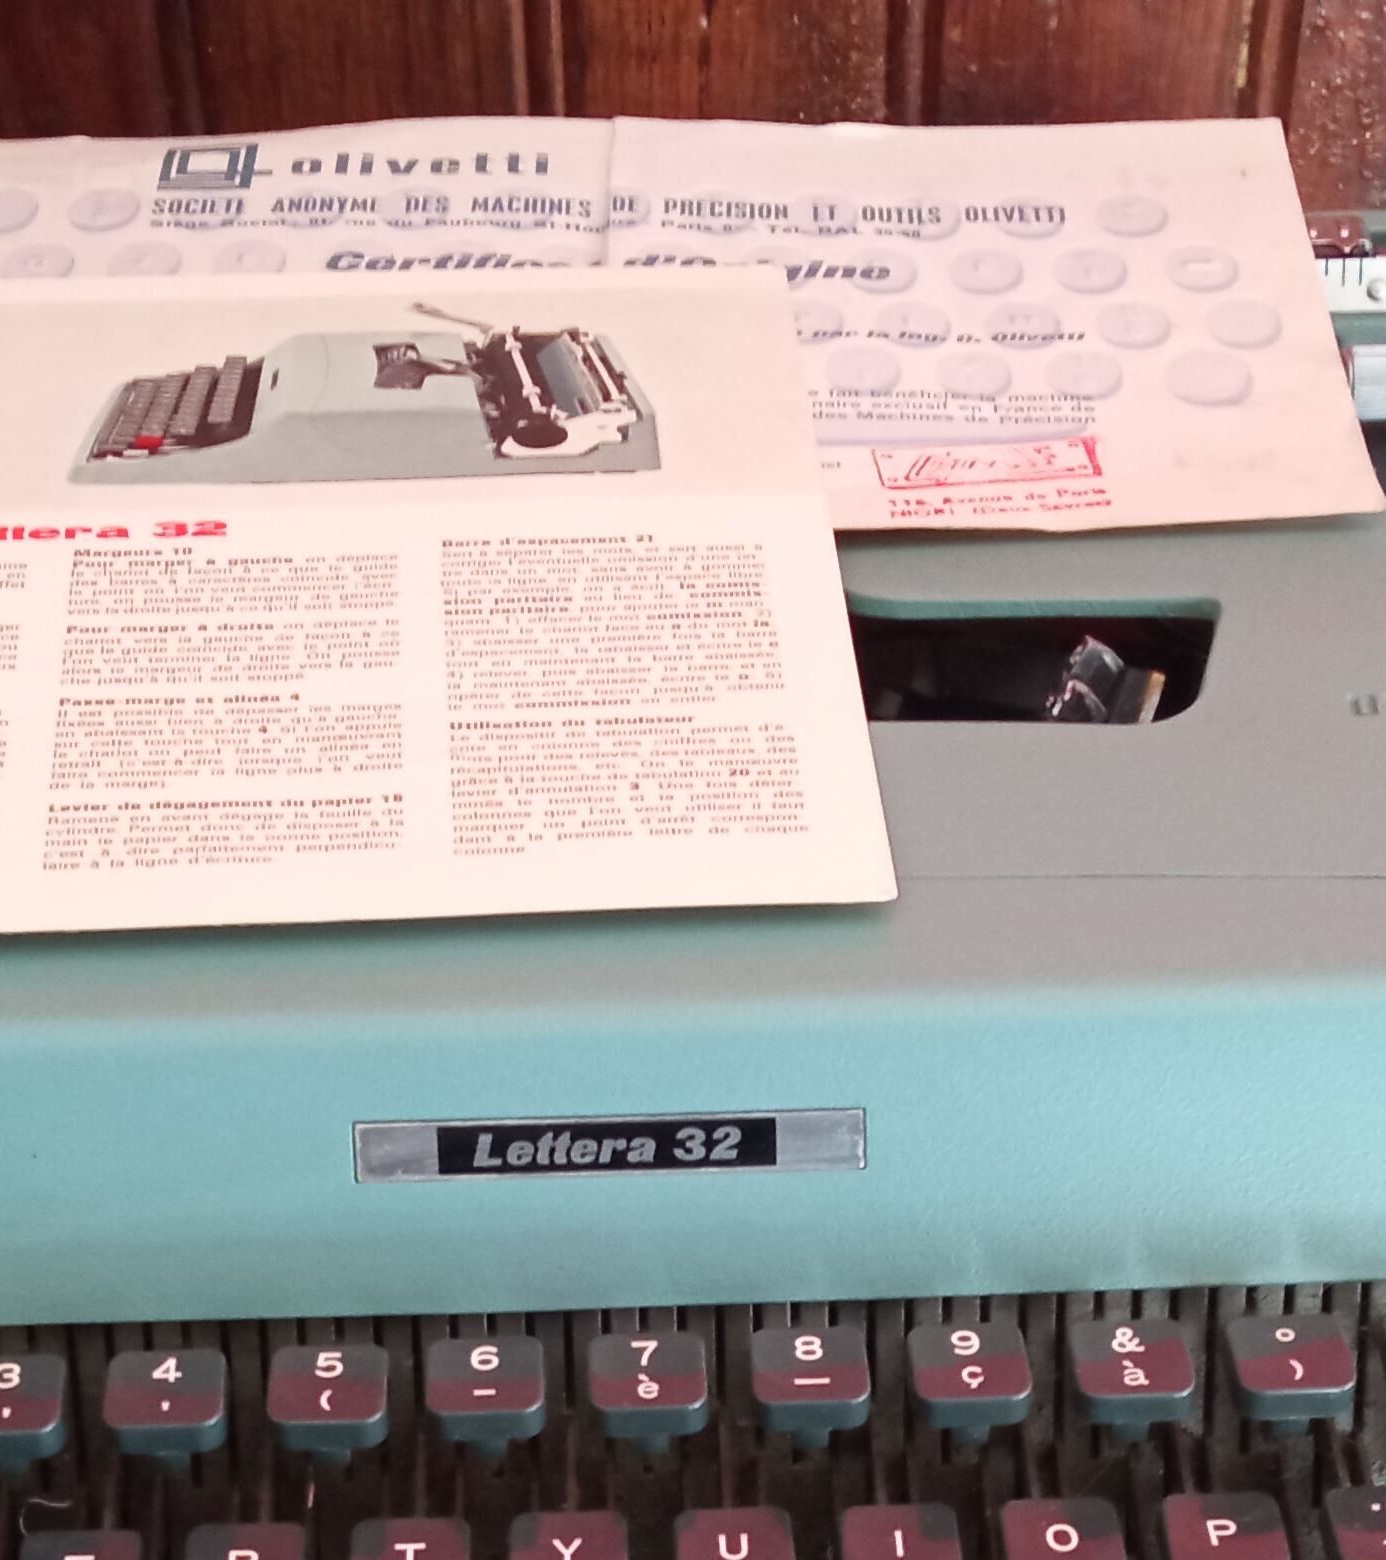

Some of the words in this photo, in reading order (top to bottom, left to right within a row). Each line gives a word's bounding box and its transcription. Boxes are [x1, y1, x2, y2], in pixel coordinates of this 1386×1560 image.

[290, 152, 549, 175] olivetti
[271, 196, 376, 214] ANONYME
[405, 196, 448, 212] DES
[471, 197, 591, 218] MACHINES
[610, 196, 637, 212] DE
[811, 204, 837, 221] ET
[860, 205, 940, 224] OUTILS
[964, 205, 1065, 224] OLIVETTI
[153, 520, 227, 538] 32
[280, 798, 303, 807] du
[473, 1129, 655, 1169] Lettera
[673, 1125, 741, 1161] 32
[153, 1358, 182, 1382] 4
[315, 1352, 343, 1377] 5
[471, 1346, 499, 1370] 6
[631, 1341, 657, 1366] 7
[795, 1336, 822, 1360] 8
[951, 1330, 980, 1355] 9
[638, 1374, 658, 1398] è
[962, 1366, 984, 1388] ç
[1123, 1360, 1149, 1385] à
[719, 1534, 748, 1560] U
[895, 1531, 903, 1557] I
[1046, 1524, 1078, 1551] O
[1207, 1520, 1236, 1546] P
